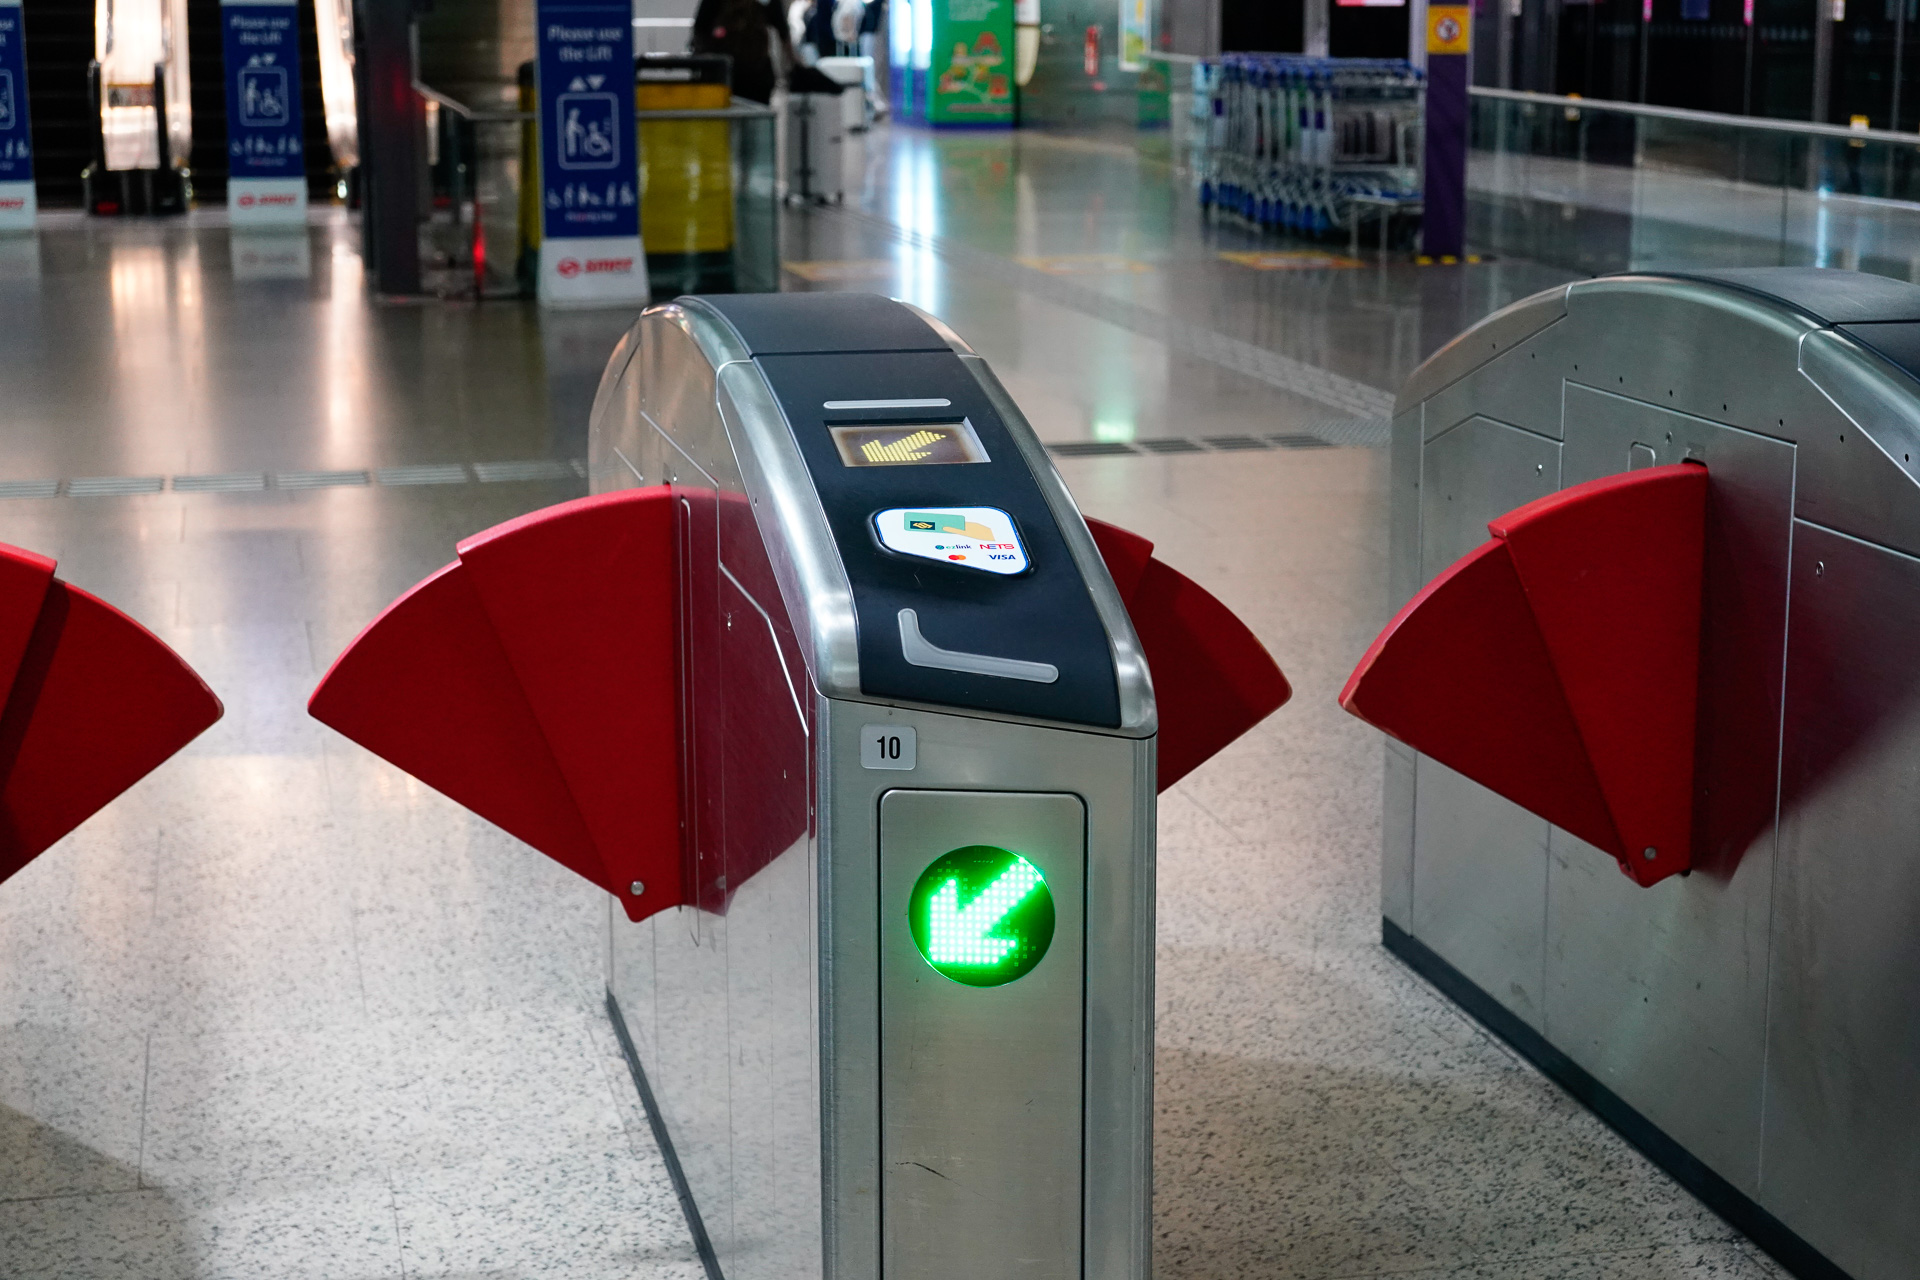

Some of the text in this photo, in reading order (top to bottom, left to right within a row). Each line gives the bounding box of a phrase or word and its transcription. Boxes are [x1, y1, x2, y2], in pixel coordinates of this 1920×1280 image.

[547, 25, 623, 40] Please use
[559, 46, 612, 61] the Lift
[877, 736, 900, 759] 10
